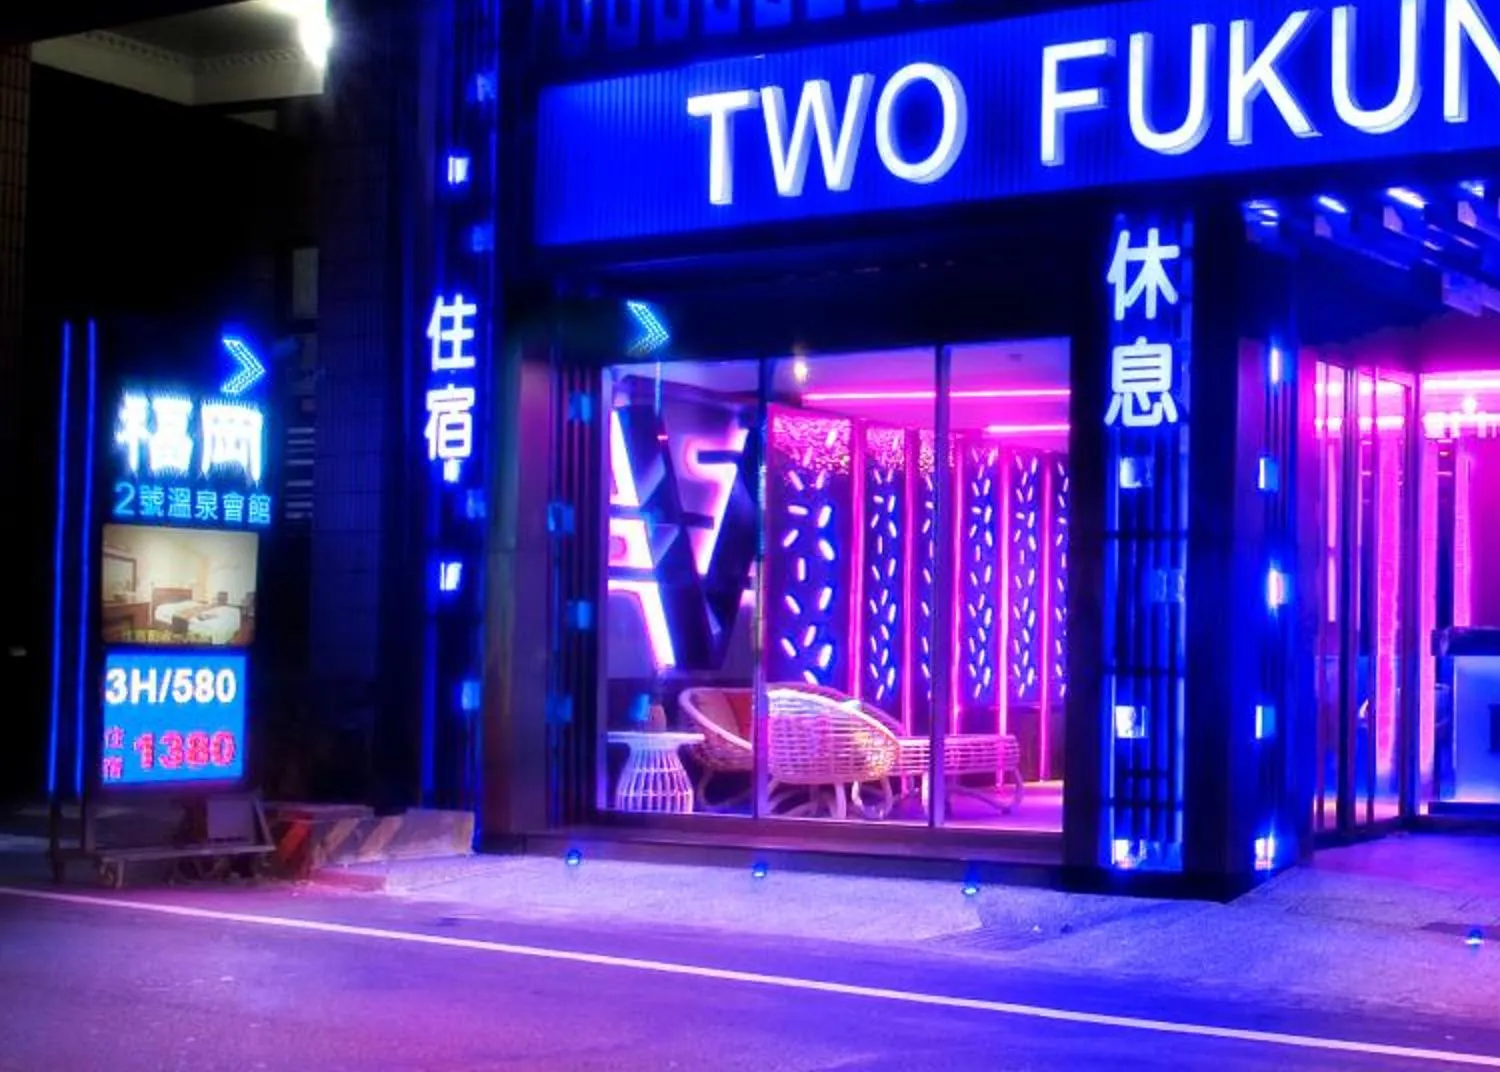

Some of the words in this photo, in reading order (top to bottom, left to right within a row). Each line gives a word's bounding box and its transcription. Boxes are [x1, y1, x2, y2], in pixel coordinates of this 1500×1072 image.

[686, 61, 968, 207] TWO
[424, 295, 477, 461] 住宿
[1104, 228, 1180, 429] 休息
[114, 394, 264, 480] 福岡
[106, 668, 237, 704] 3H/580
[134, 731, 236, 770] 1380
